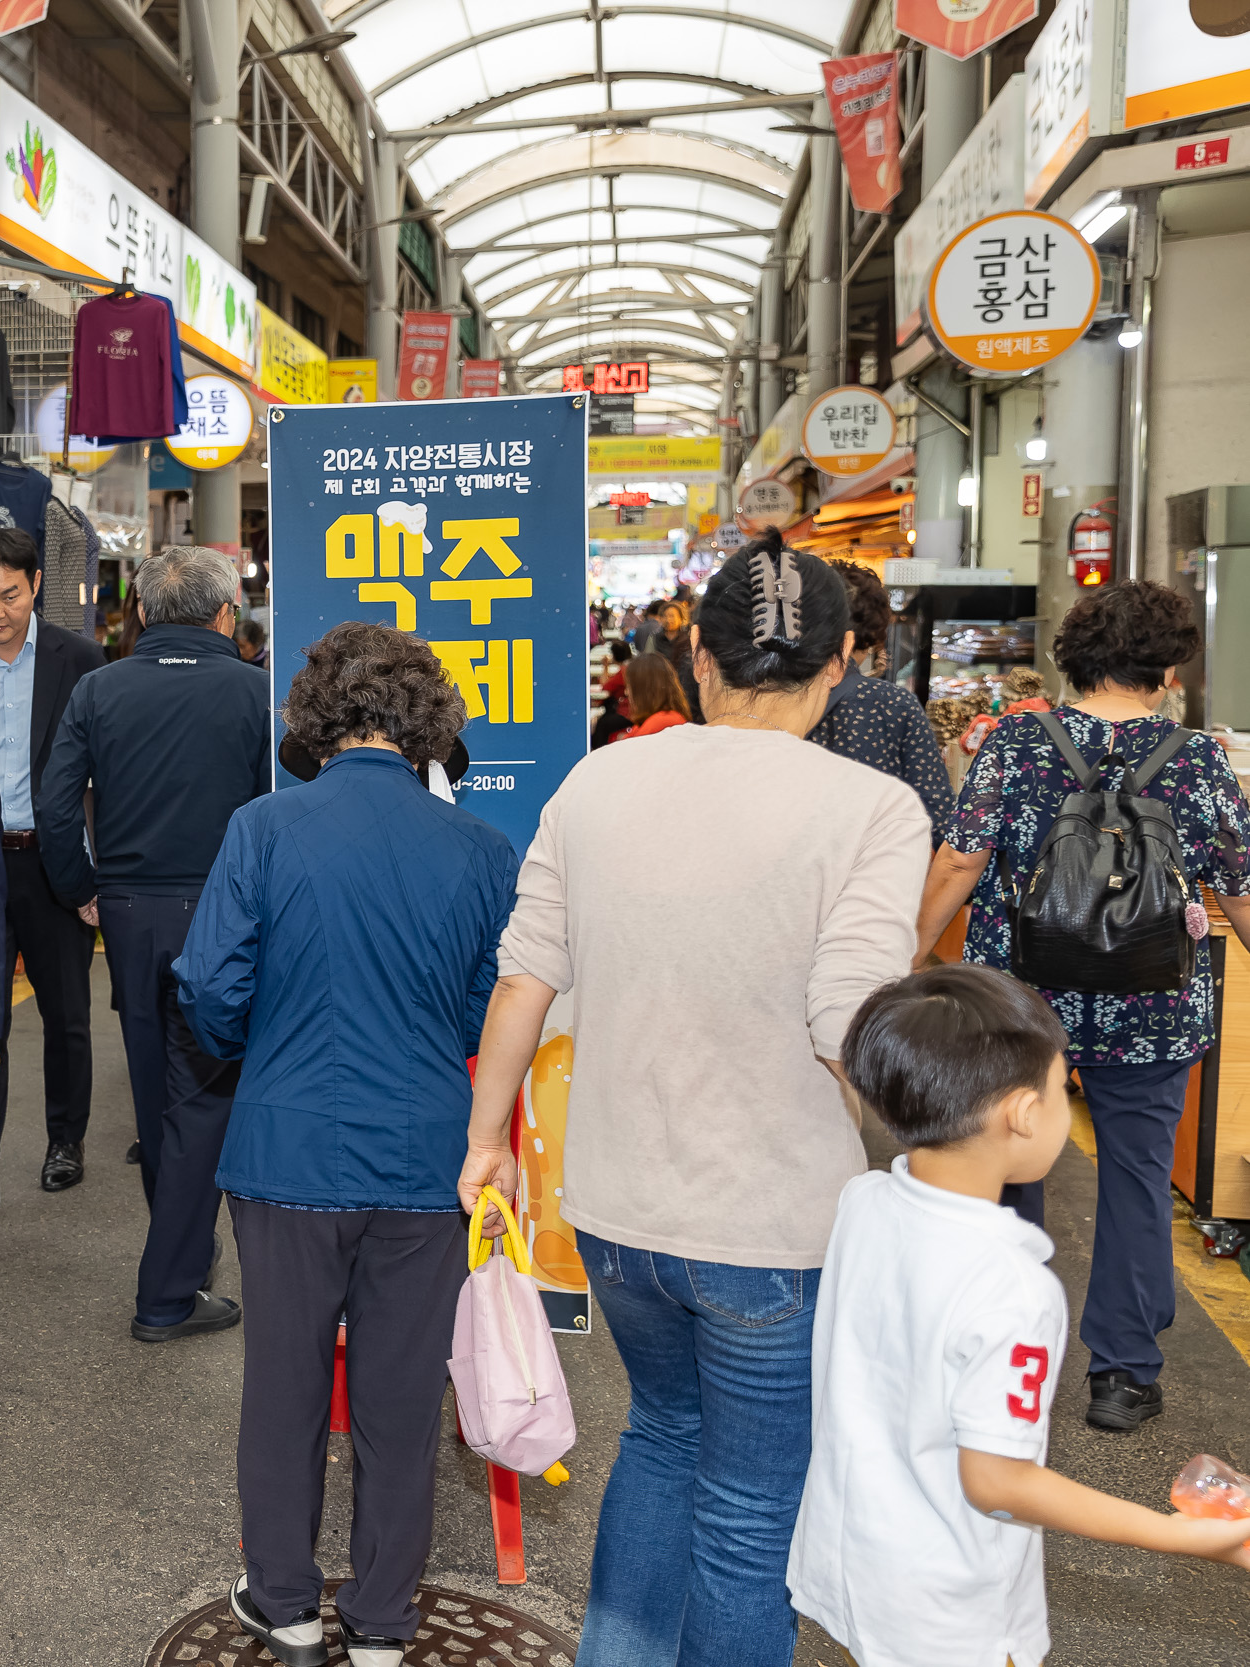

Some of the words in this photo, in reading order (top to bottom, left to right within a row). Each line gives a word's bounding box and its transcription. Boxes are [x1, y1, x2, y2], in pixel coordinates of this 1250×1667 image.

[1194, 143, 1207, 162] 5
[106, 193, 173, 285] 으뜸채소
[973, 233, 1057, 279] 금산
[973, 279, 1056, 323] 홍삼
[976, 336, 1050, 359] 원액제조
[188, 389, 229, 414] 으뜸
[186, 416, 229, 438] 채소
[820, 404, 879, 426] 우리집
[829, 427, 869, 449] 반찬
[322, 447, 378, 472] 2024
[384, 439, 534, 471] 자양전통시장
[324, 479, 343, 495] 제
[351, 477, 380, 496] 2회
[389, 475, 447, 498] 고객과
[454, 471, 532, 497] 함께하는
[1008, 1343, 1049, 1424] 3
